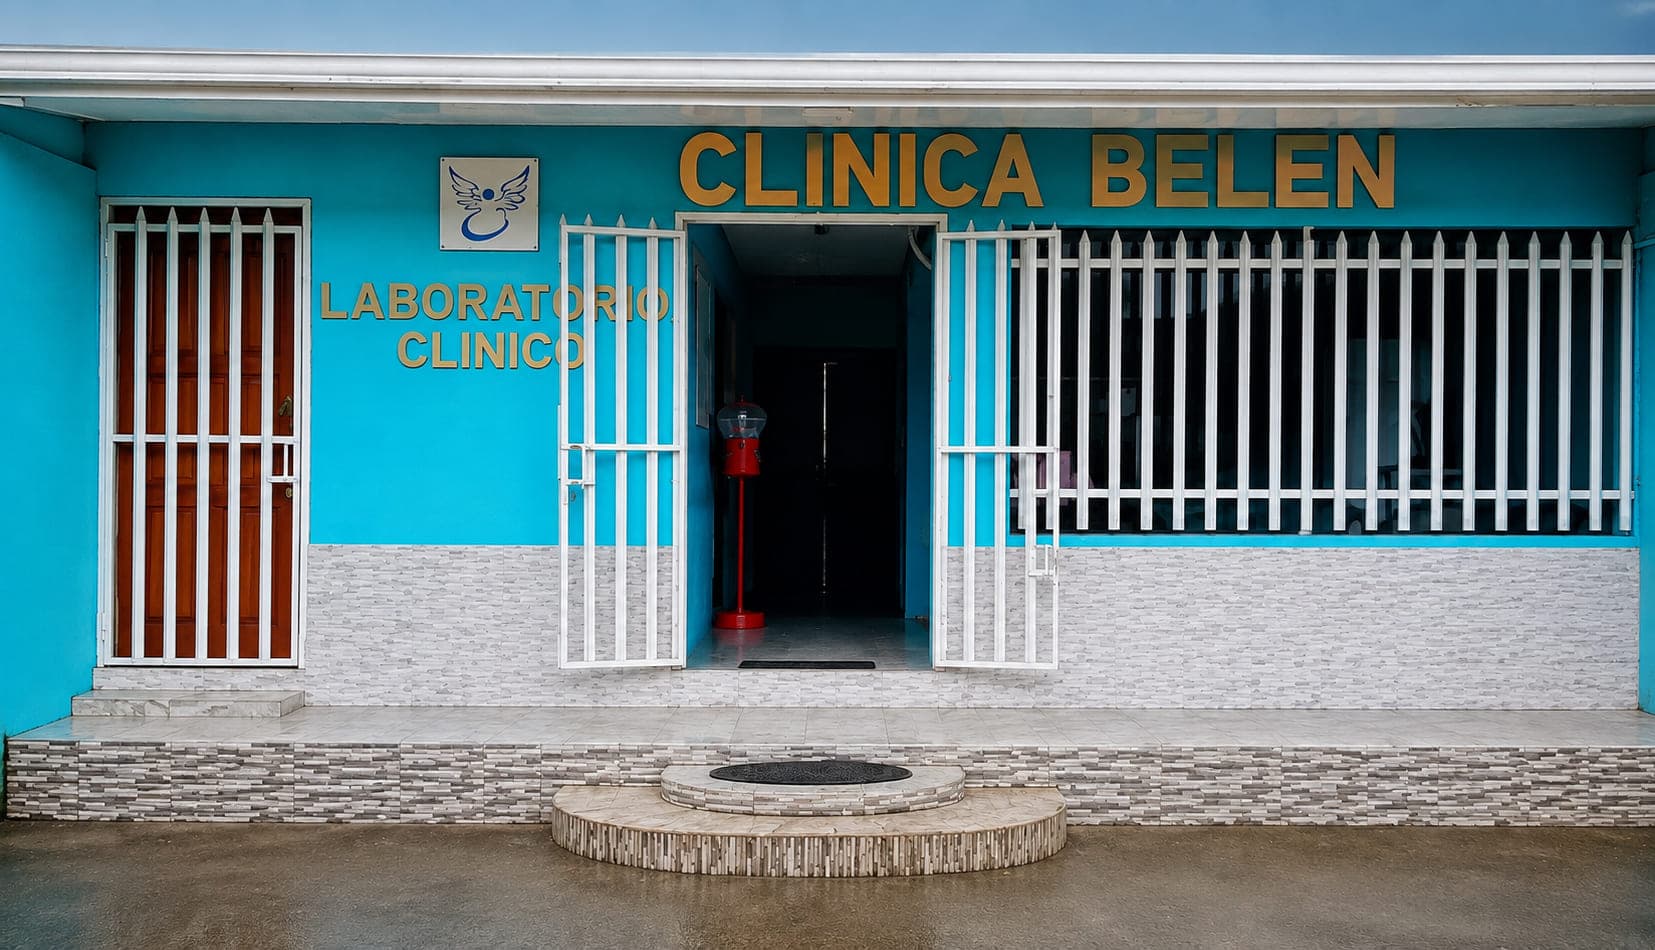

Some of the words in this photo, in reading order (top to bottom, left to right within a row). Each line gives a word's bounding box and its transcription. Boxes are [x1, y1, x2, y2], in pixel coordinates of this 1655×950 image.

[679, 132, 1044, 207] CLINICA
[1091, 134, 1396, 208] BELEN
[320, 282, 669, 321] LABORATORIO
[397, 331, 585, 369] CLINICO
